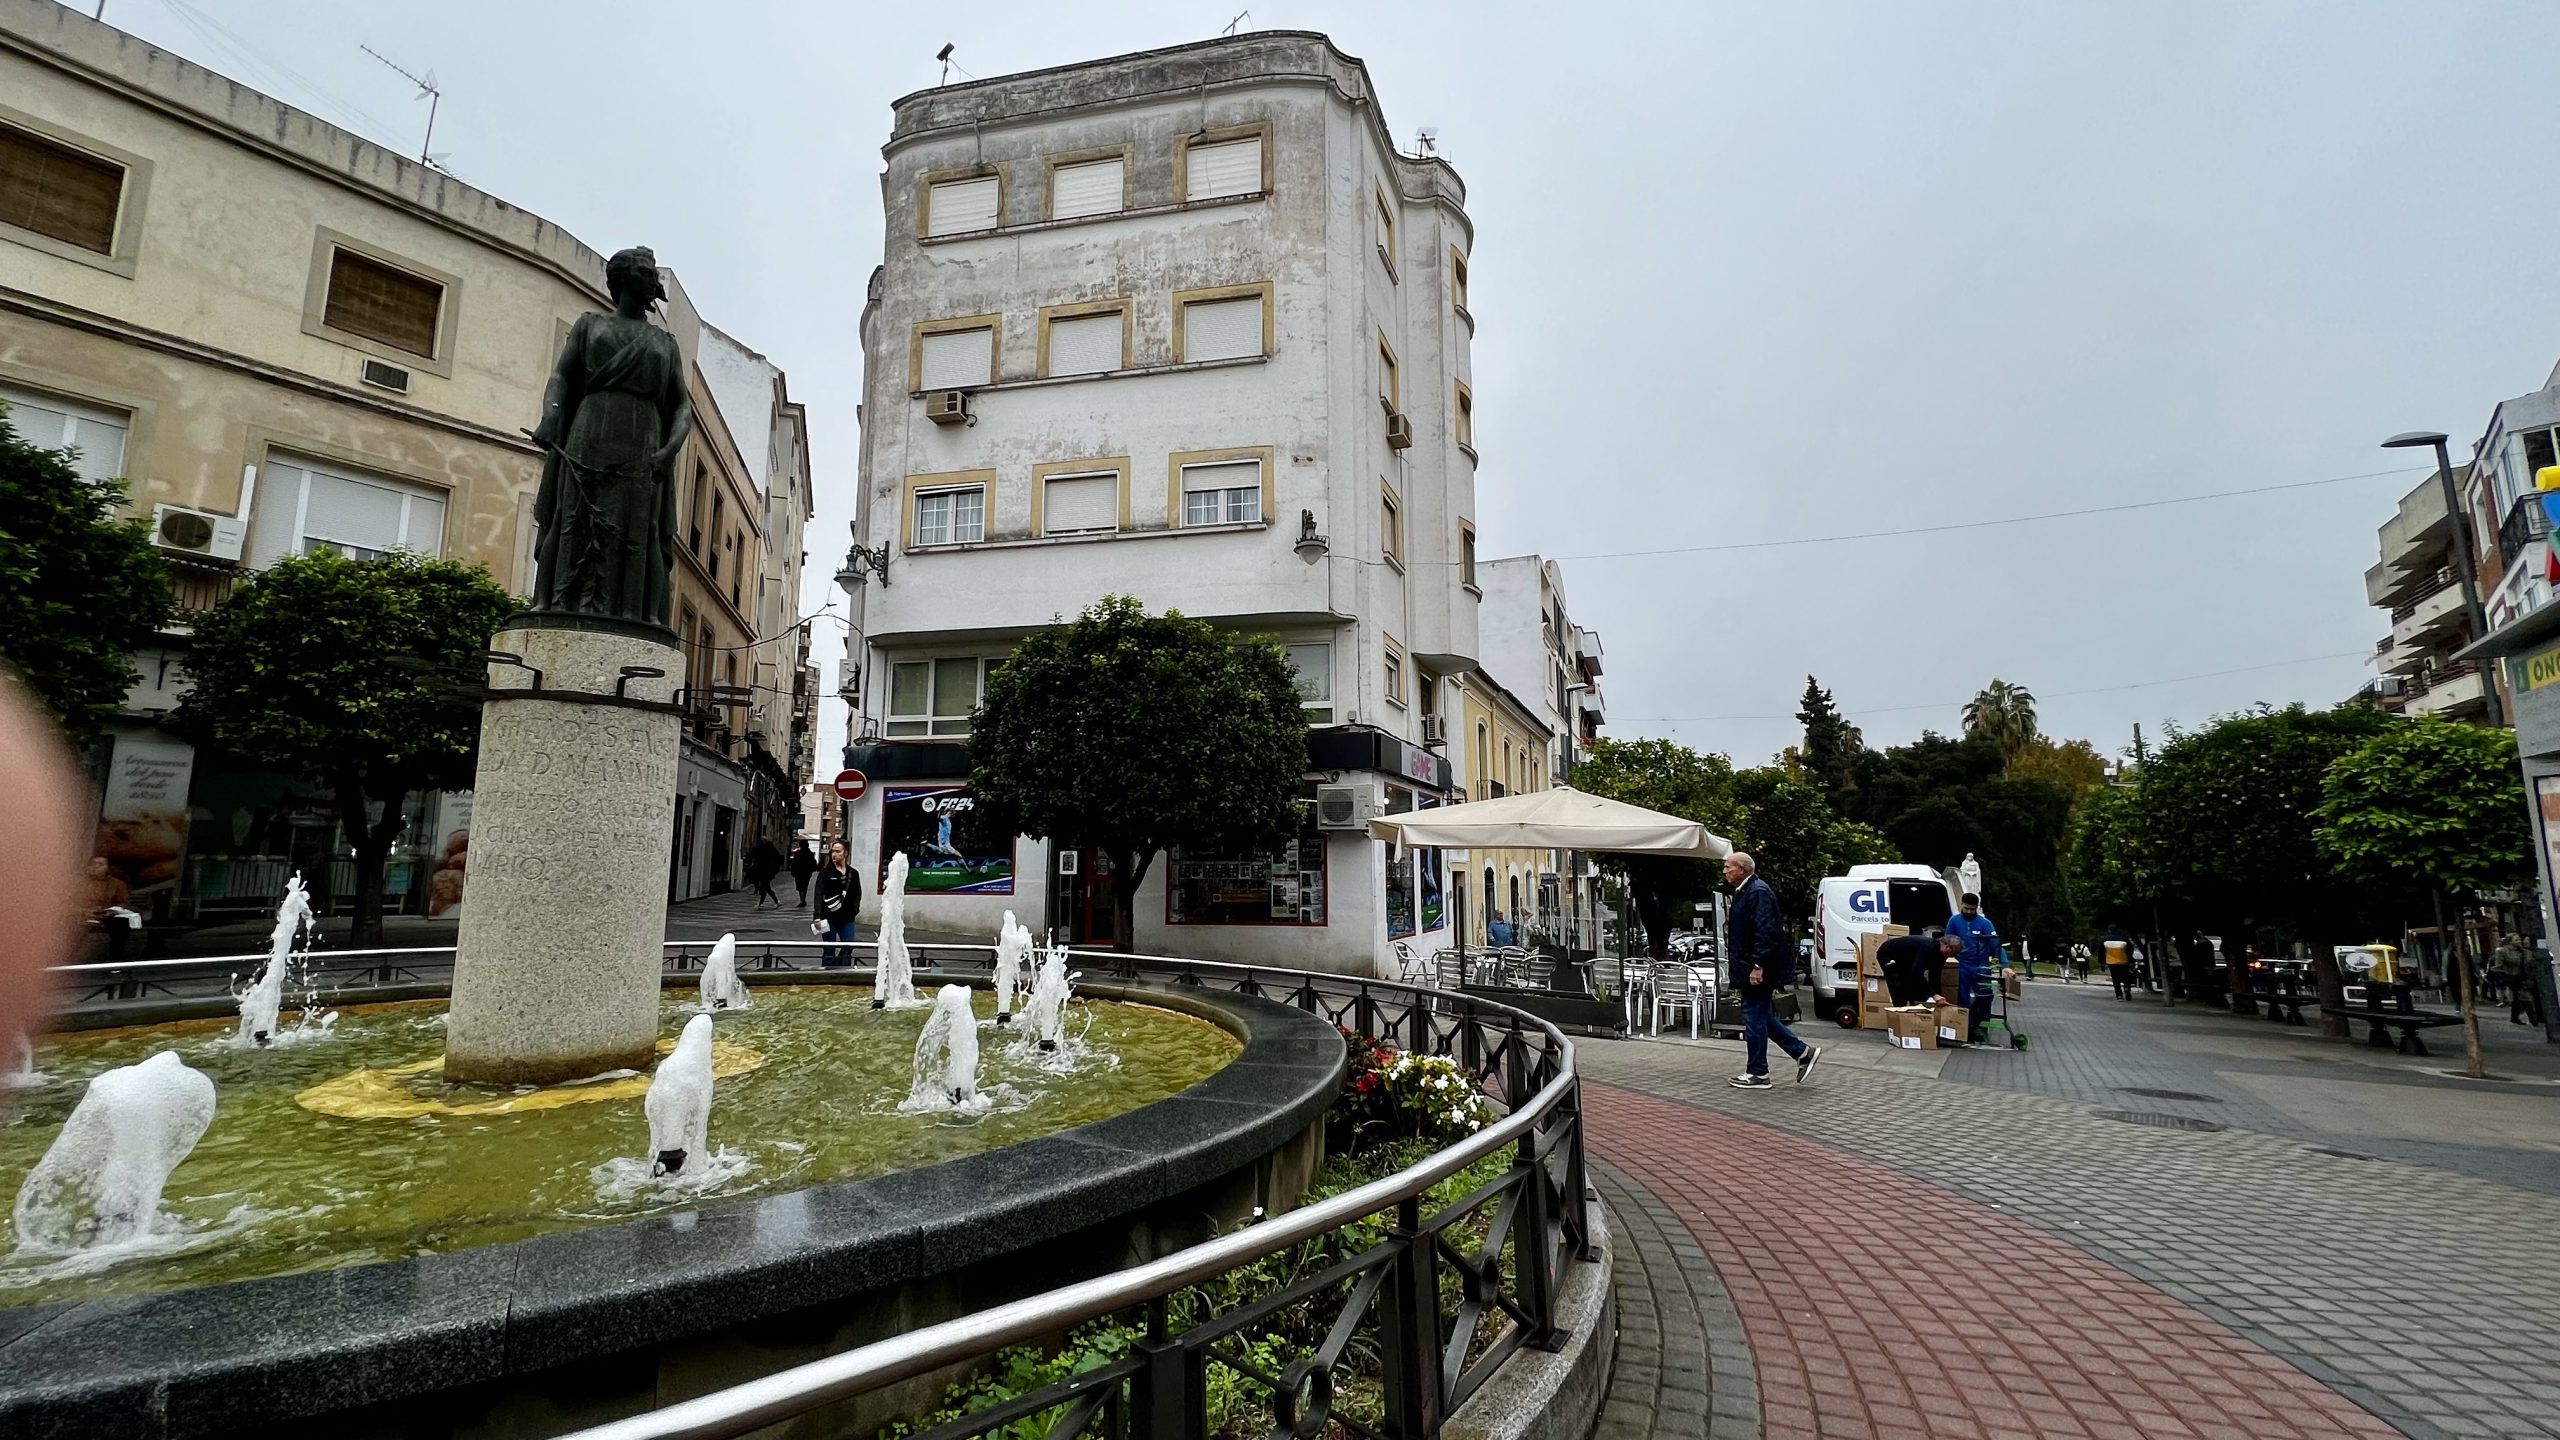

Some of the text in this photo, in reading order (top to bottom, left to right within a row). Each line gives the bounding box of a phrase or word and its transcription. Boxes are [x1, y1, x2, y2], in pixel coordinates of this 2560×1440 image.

[1411, 750, 1431, 781] GAME
[1849, 890, 1889, 912] GL
[1851, 915, 1890, 923] Parcels to
[1843, 970, 1857, 979] 607
